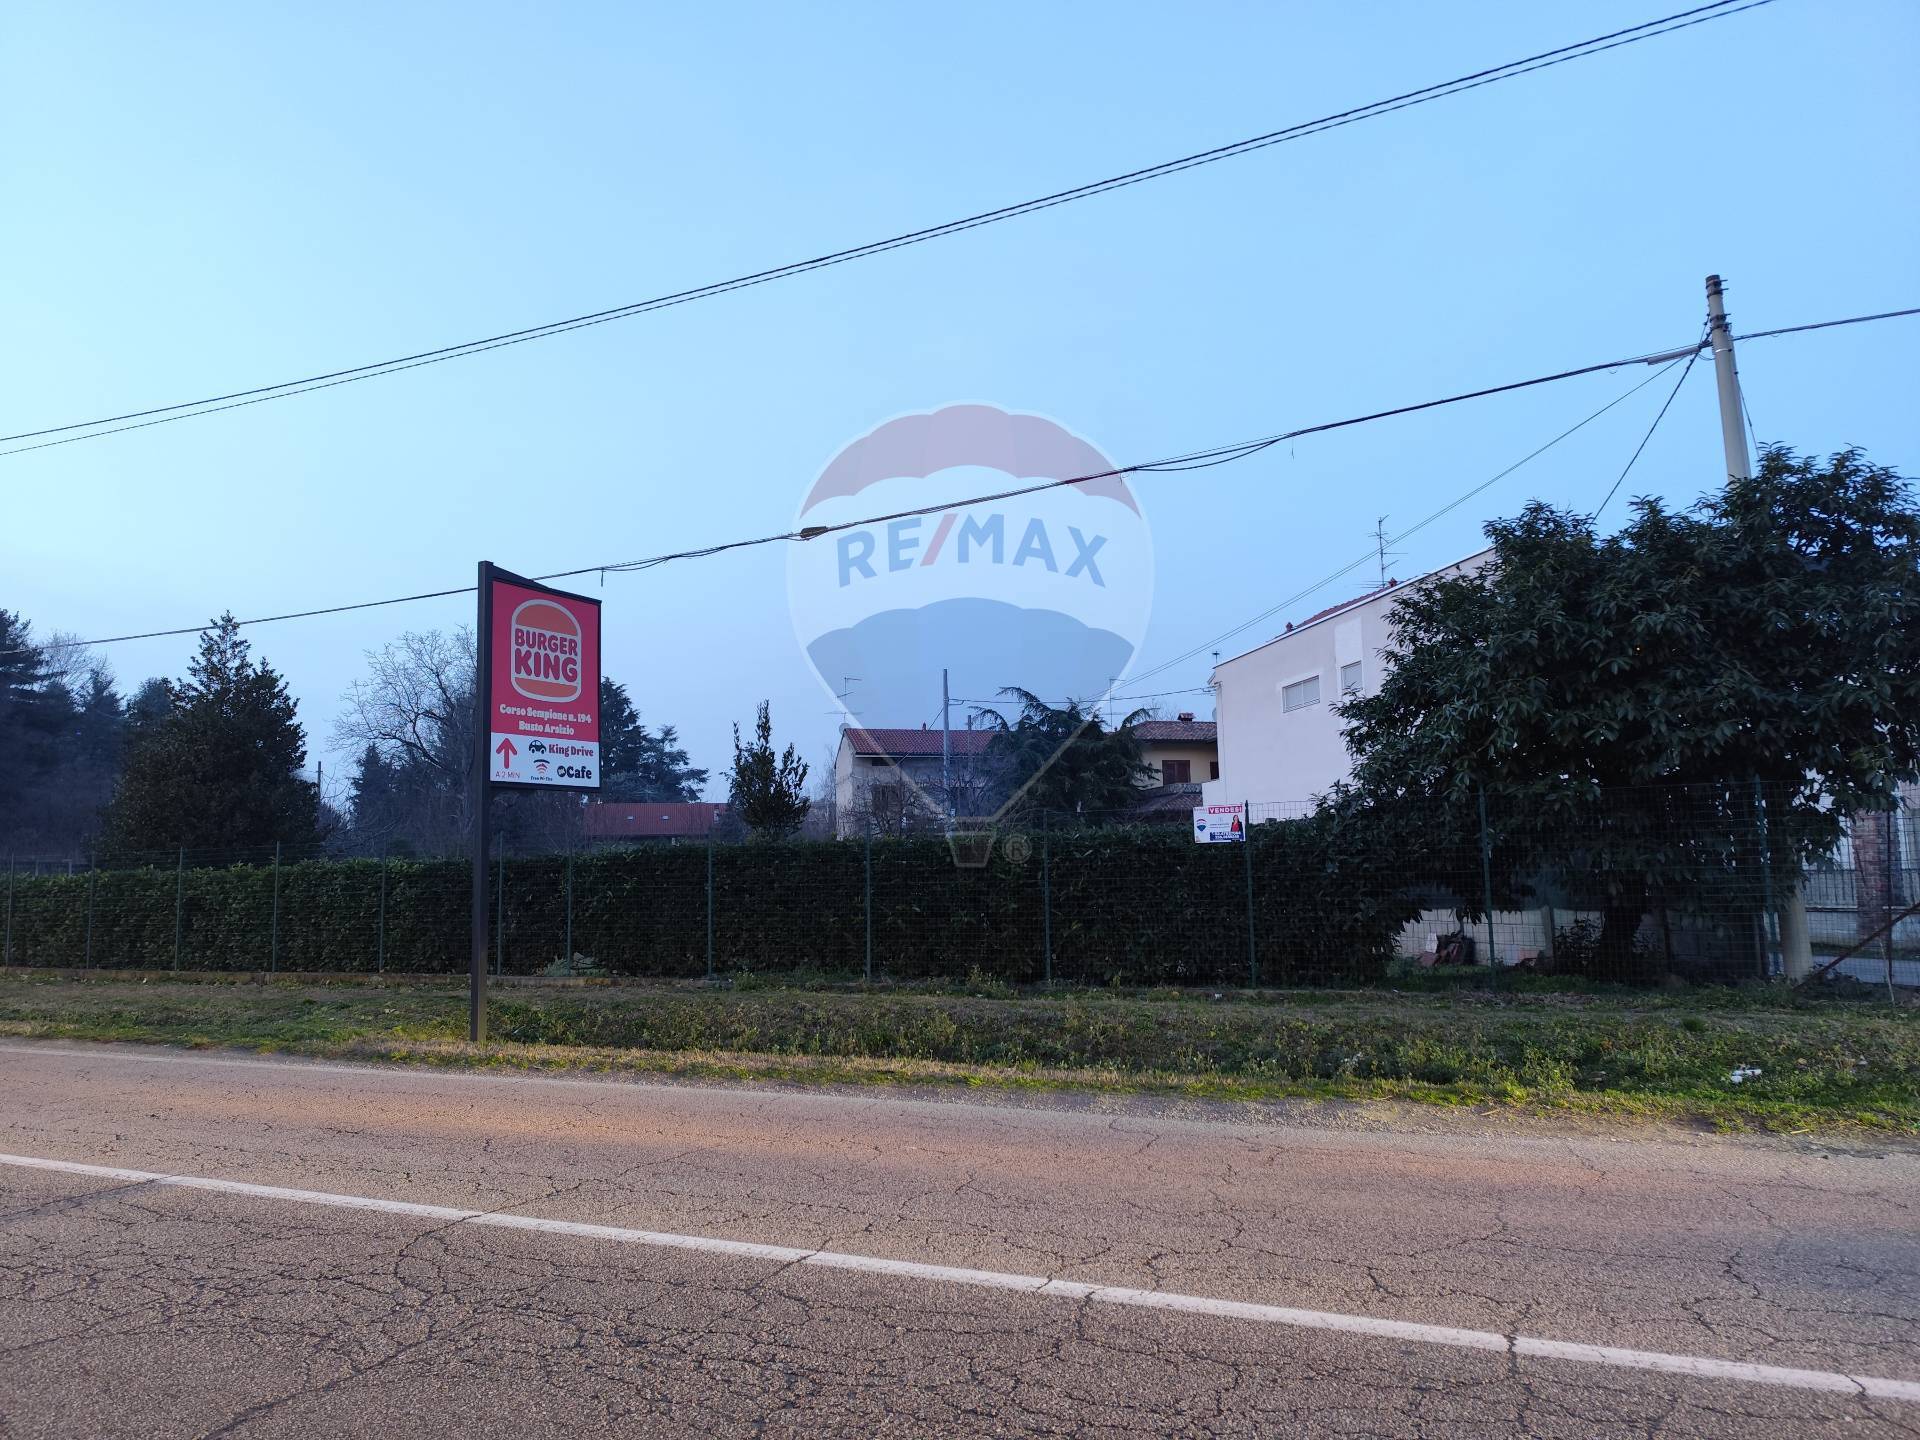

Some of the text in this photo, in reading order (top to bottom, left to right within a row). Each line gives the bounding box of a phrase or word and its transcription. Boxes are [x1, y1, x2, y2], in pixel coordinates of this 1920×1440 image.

[515, 628, 578, 656] BURGER
[515, 648, 578, 682] KING
[500, 704, 592, 724] Corso Sempione n. 194
[518, 720, 575, 736] Busto Arsizio
[548, 743, 594, 758] King Drive
[507, 771, 520, 779] MIN
[567, 765, 592, 780] Cafe
[1209, 806, 1242, 814] VENDESI
